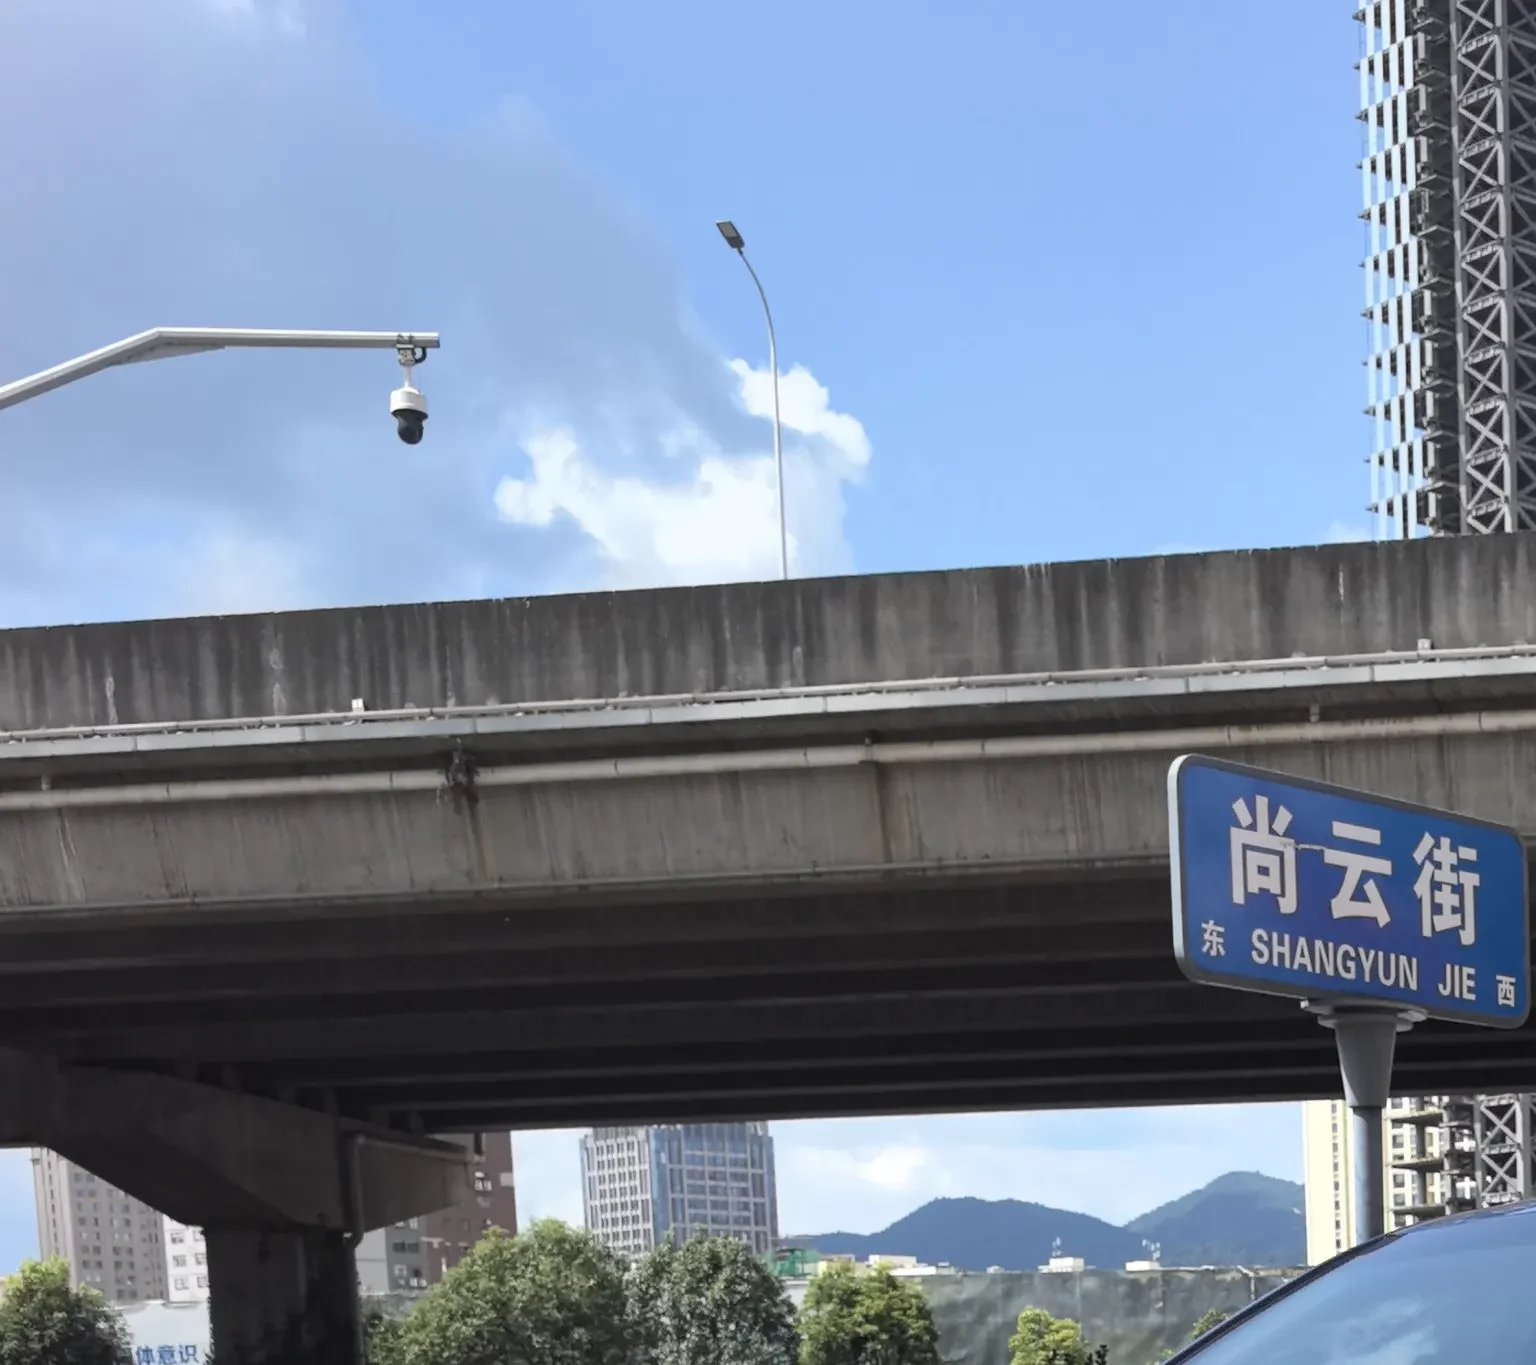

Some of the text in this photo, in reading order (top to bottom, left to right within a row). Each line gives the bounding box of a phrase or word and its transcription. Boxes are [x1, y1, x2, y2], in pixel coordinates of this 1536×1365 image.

[1229, 795, 1481, 946] 尚云街
[1201, 919, 1516, 1008] 东 SHANGYUN JIE 西
